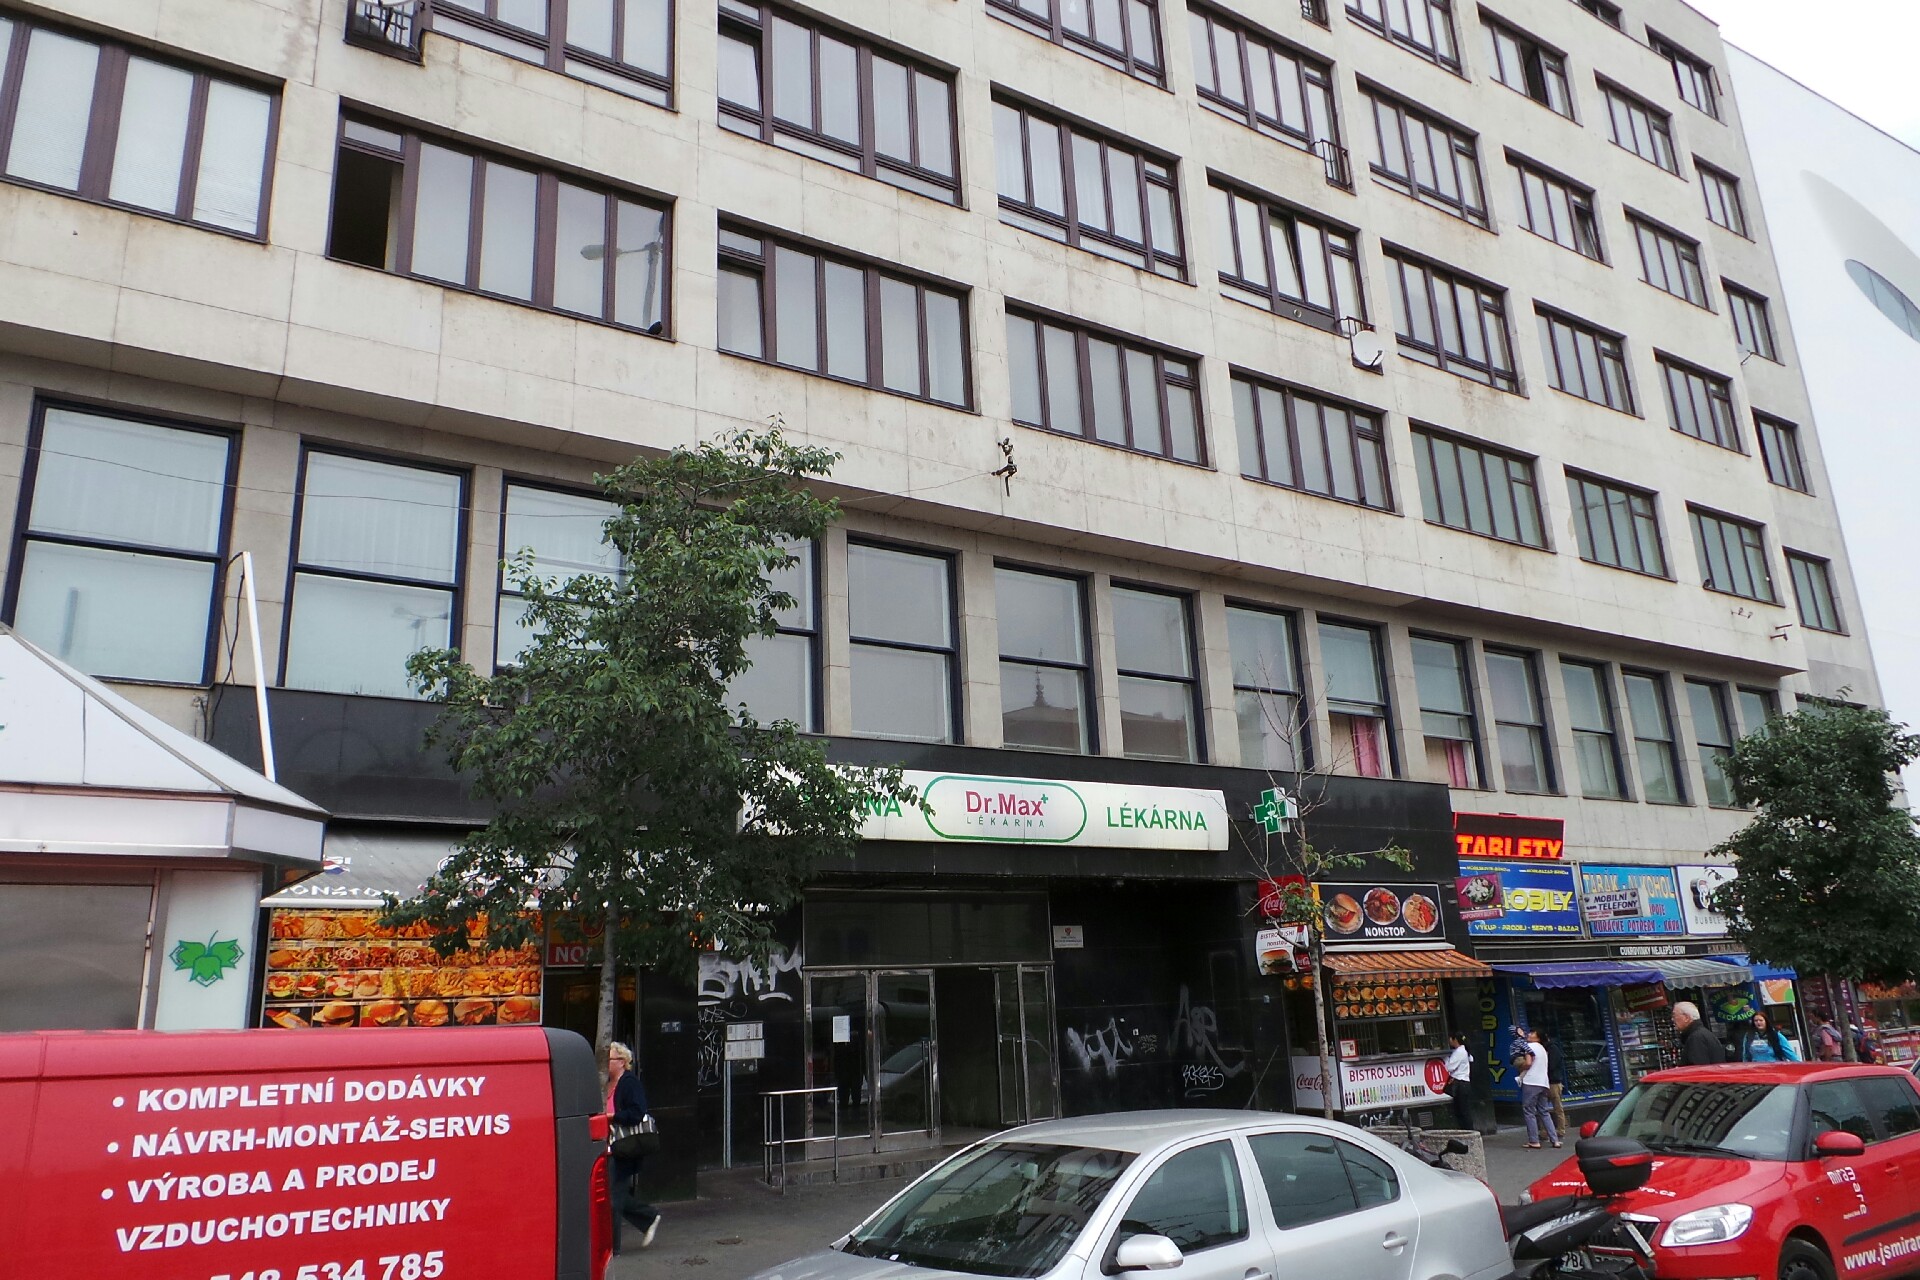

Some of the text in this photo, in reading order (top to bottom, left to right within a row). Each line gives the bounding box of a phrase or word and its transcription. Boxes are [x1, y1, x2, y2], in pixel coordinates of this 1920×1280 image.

[965, 790, 1045, 817] Dr.Max
[1106, 802, 1209, 832] LÉKÁRNA
[966, 814, 1046, 829] LÉKÁRNA
[1593, 892, 1628, 904] MOBILNÍ
[1598, 900, 1638, 911] TELEFONY
[1364, 926, 1406, 938] NONSTOP
[1478, 979, 1508, 1084] MOBILY
[1349, 1064, 1416, 1083] BISTRO SUSHI
[137, 1074, 486, 1112] KOMPLETNÍ DODÁVKY
[132, 1114, 510, 1158] NÁVRH-MONTÁŽ-SERVIS
[127, 1158, 436, 1203] VÝROBA A PRODEJ
[116, 1198, 451, 1252] VZDUCHOTECHNIKY
[295, 1259, 366, 1280] 534
[377, 1250, 444, 1280] 785
